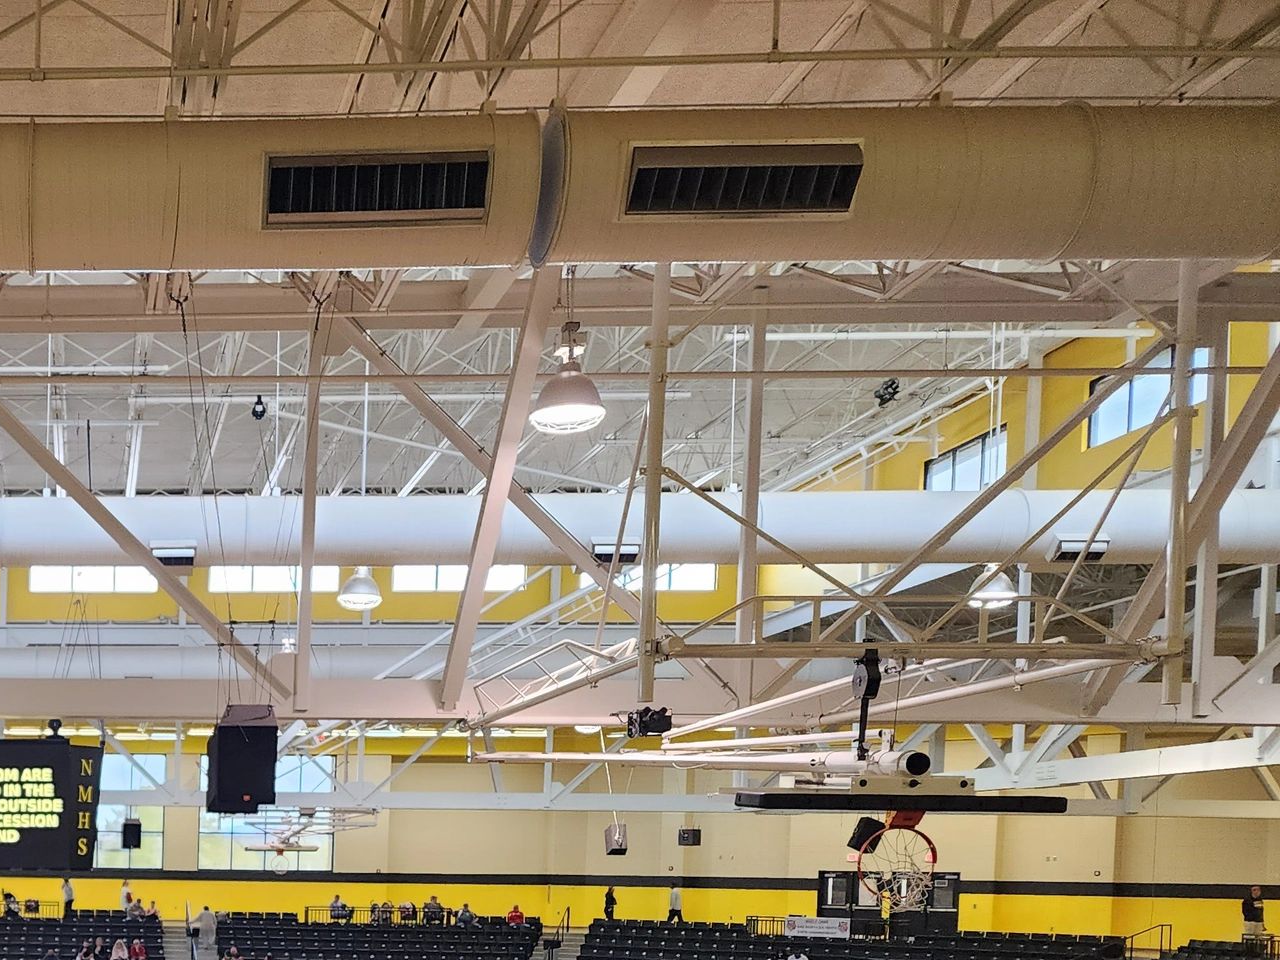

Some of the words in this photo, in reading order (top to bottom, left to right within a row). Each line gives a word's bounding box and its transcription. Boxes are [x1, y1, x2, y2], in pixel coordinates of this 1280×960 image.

[21, 768, 53, 782] ARE
[3, 783, 21, 797] IN
[22, 783, 55, 797] THE
